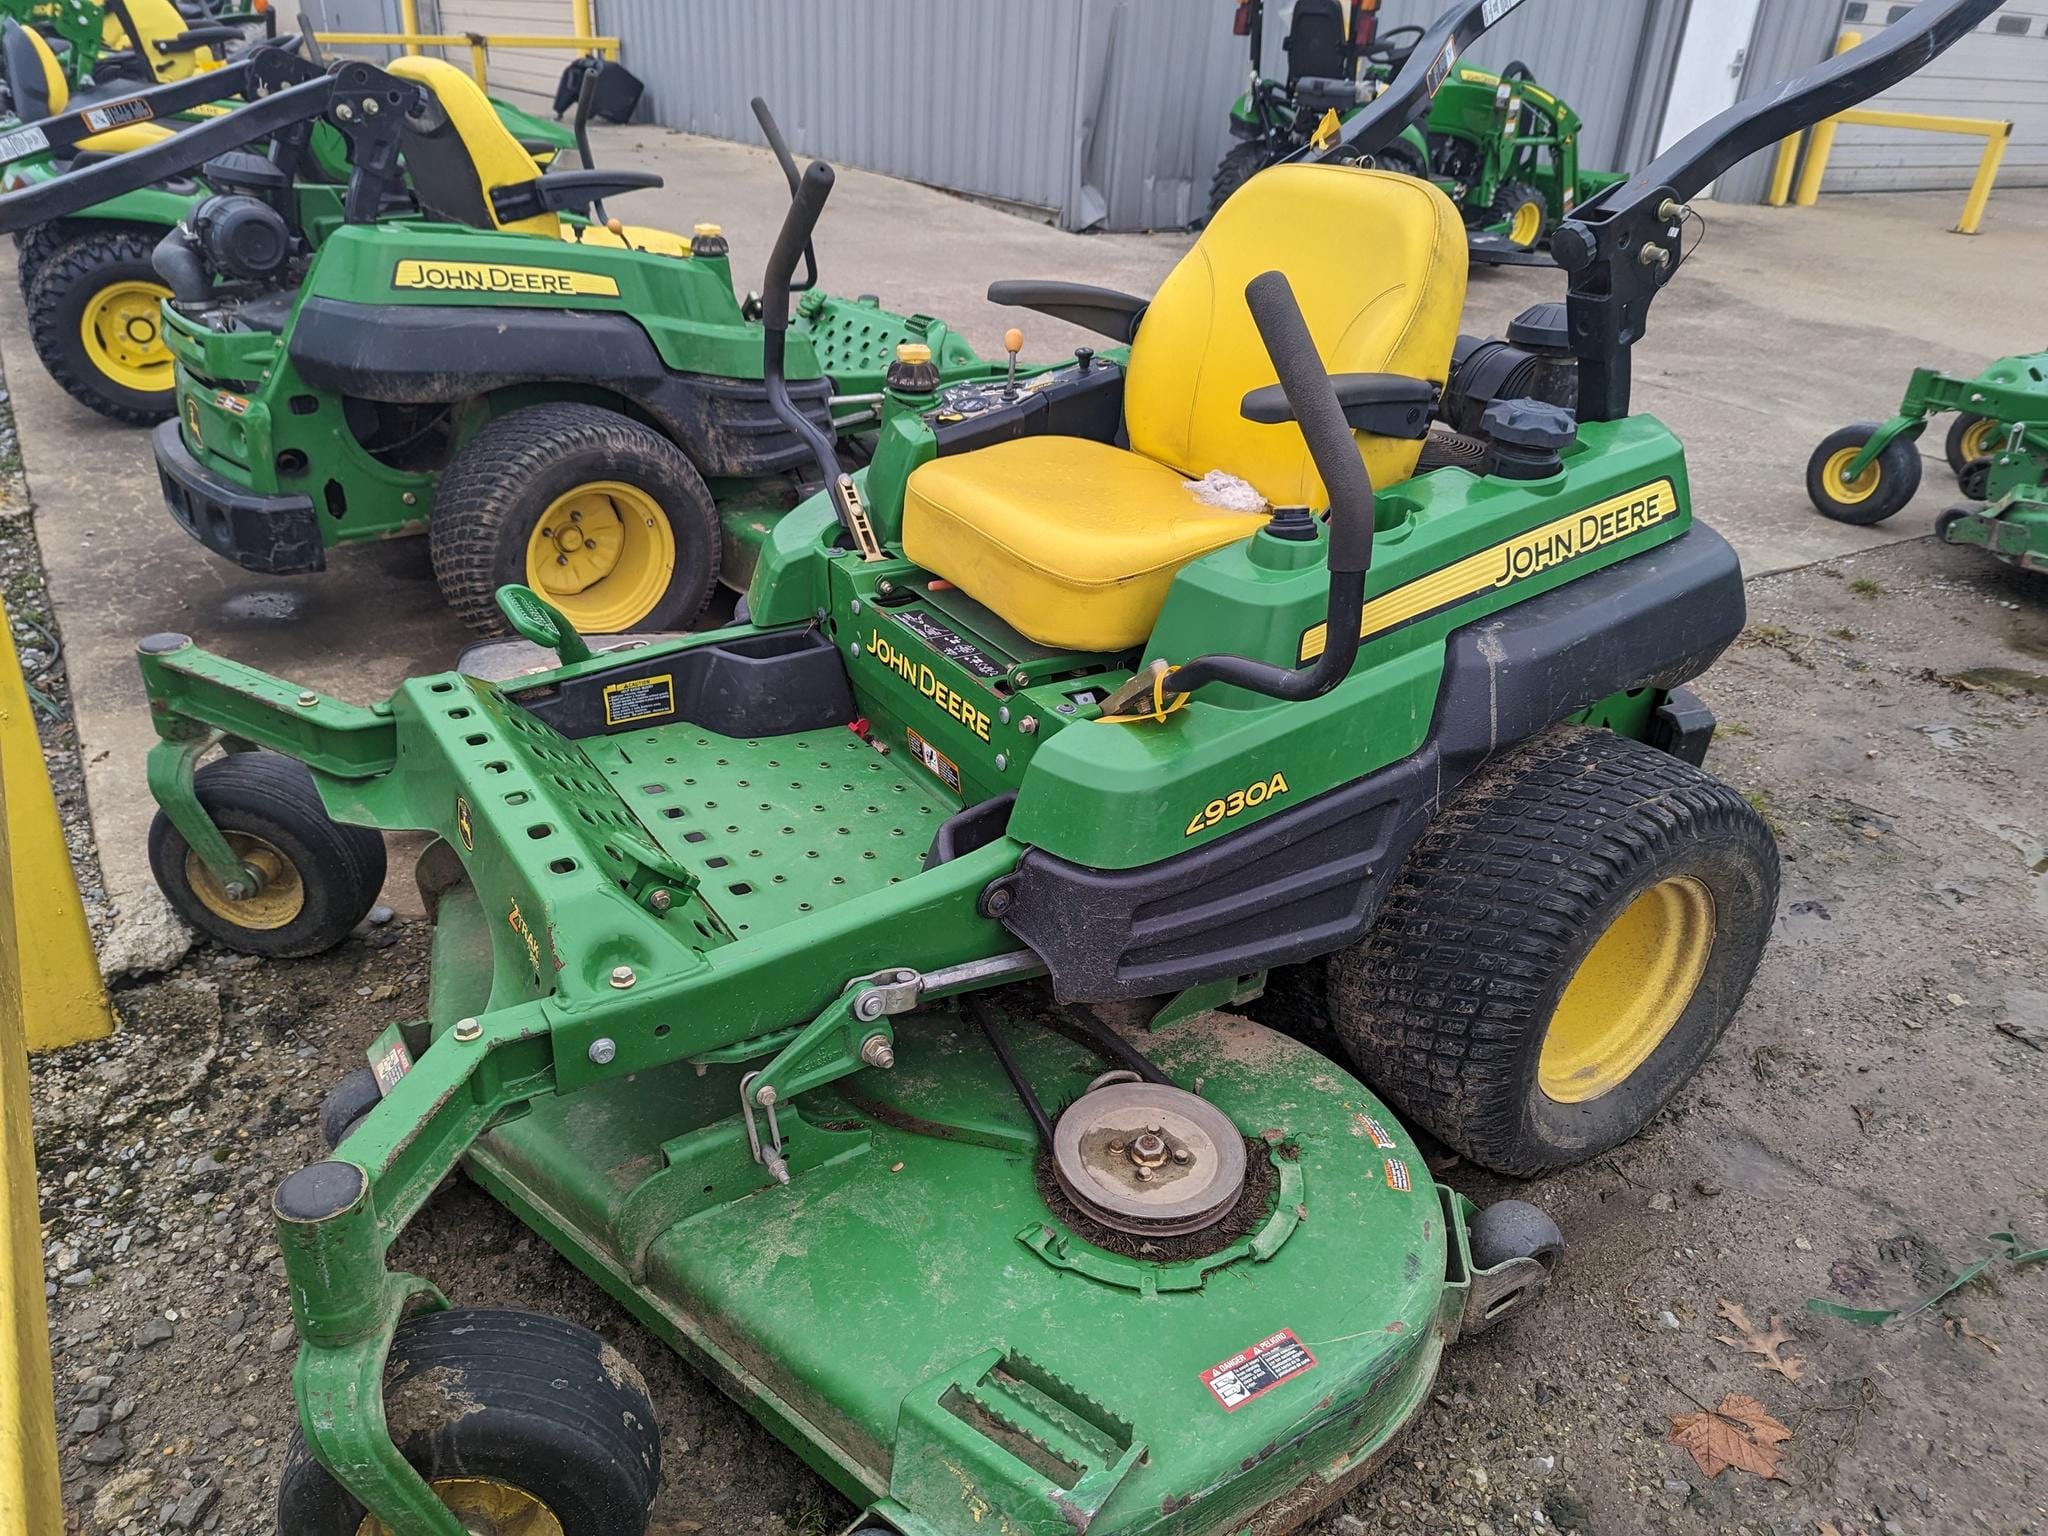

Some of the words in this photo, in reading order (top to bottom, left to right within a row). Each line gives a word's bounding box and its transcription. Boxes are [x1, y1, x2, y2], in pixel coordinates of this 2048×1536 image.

[412, 265, 484, 286] JOHN
[489, 268, 574, 292] DEERE
[1495, 529, 1572, 584] JOHN
[1579, 494, 1660, 547] DEERE
[866, 628, 917, 687] JOHN
[919, 663, 991, 742] DEERE
[1185, 772, 1290, 837] Z930A
[1219, 1354, 1247, 1372] DANGER
[1259, 1332, 1287, 1350] PELIGRO
